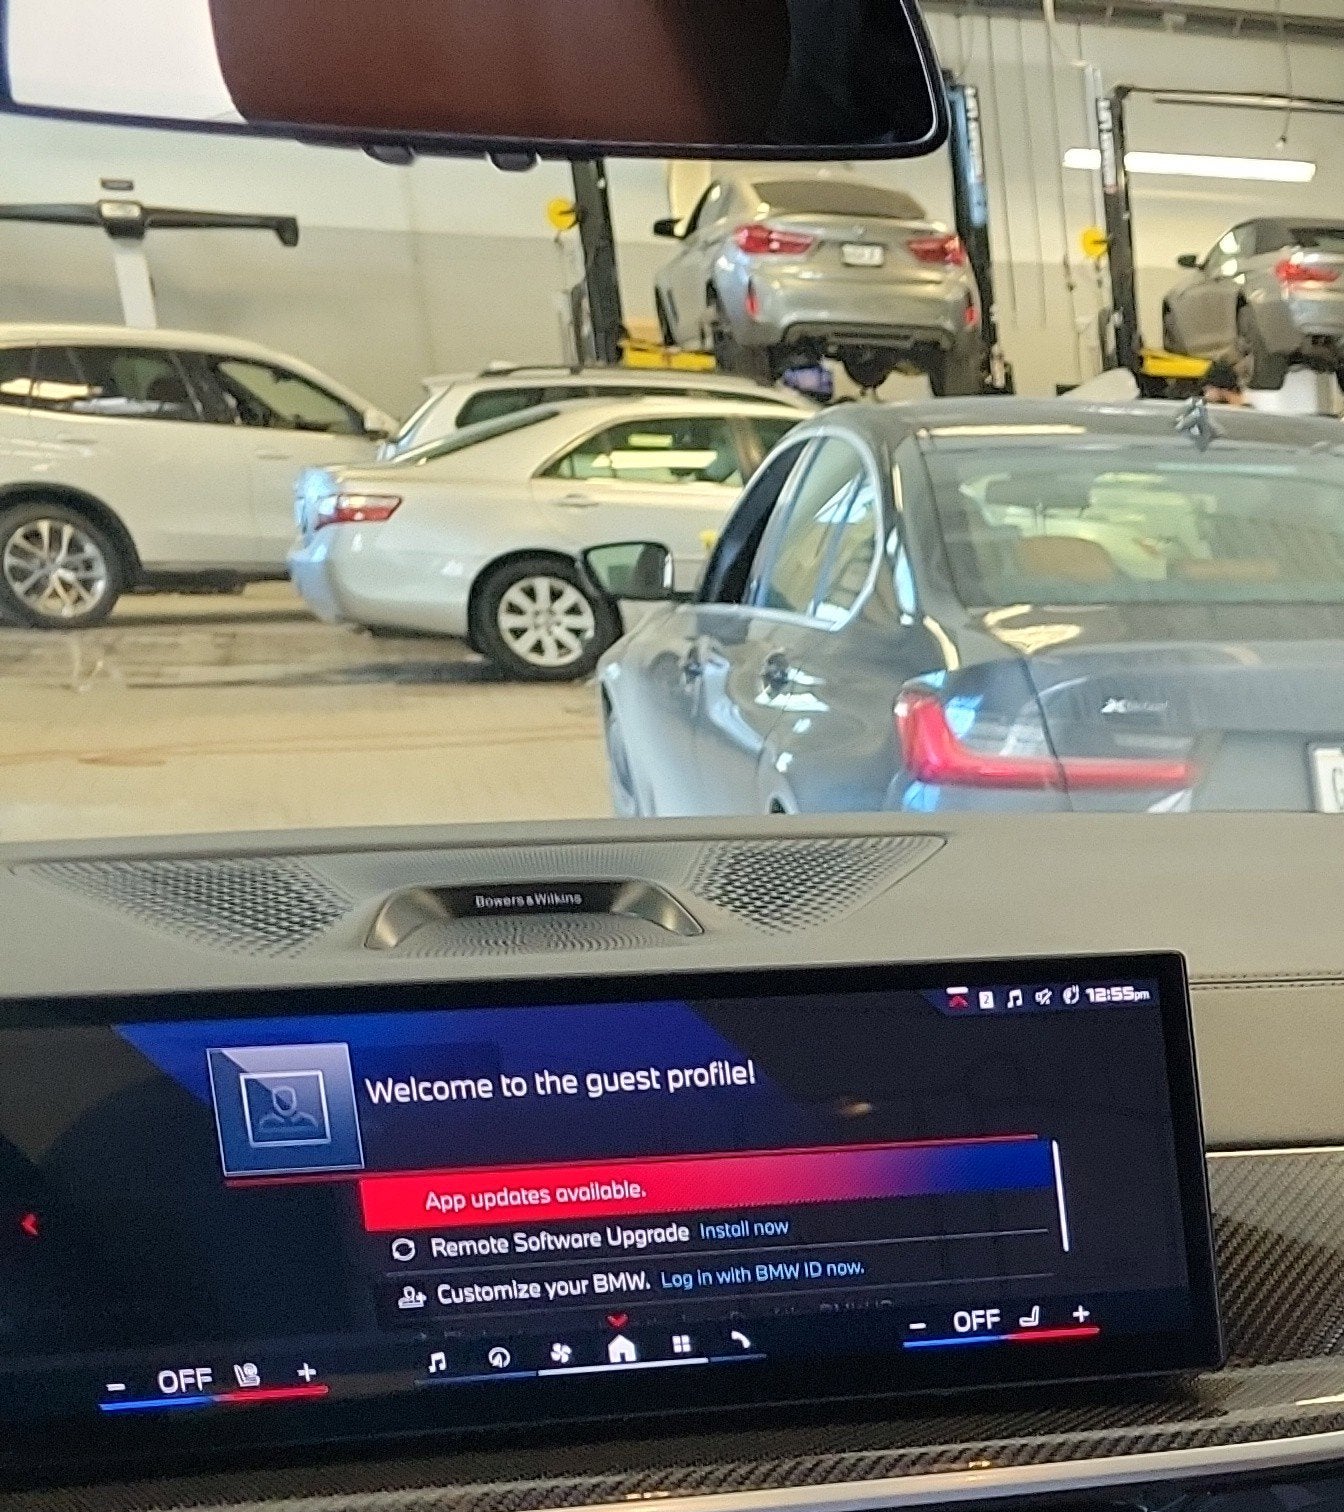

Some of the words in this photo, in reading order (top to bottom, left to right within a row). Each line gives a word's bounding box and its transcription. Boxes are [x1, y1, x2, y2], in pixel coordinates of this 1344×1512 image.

[364, 1075, 493, 1104] Welcome
[500, 1073, 528, 1097] to
[534, 1069, 578, 1095] the
[585, 1067, 661, 1098] guest
[667, 1059, 756, 1093] profile!
[425, 1191, 467, 1213] App
[471, 1187, 551, 1211] updates
[556, 1180, 648, 1203] available.
[431, 1236, 509, 1258] Remote
[513, 1230, 602, 1253] Software
[606, 1223, 690, 1249] Upgrade
[700, 1220, 750, 1240] Install
[754, 1221, 789, 1236] now
[437, 1279, 541, 1305] Customize
[545, 1278, 589, 1300] your
[592, 1270, 651, 1294] BMW.
[661, 1270, 693, 1291] Log
[697, 1269, 713, 1286] in
[716, 1266, 751, 1285] with
[755, 1262, 800, 1282] BMW
[804, 1261, 823, 1278] ID
[826, 1260, 866, 1278] now.
[953, 1308, 1001, 1333] OFF
[157, 1367, 213, 1394] OFF
